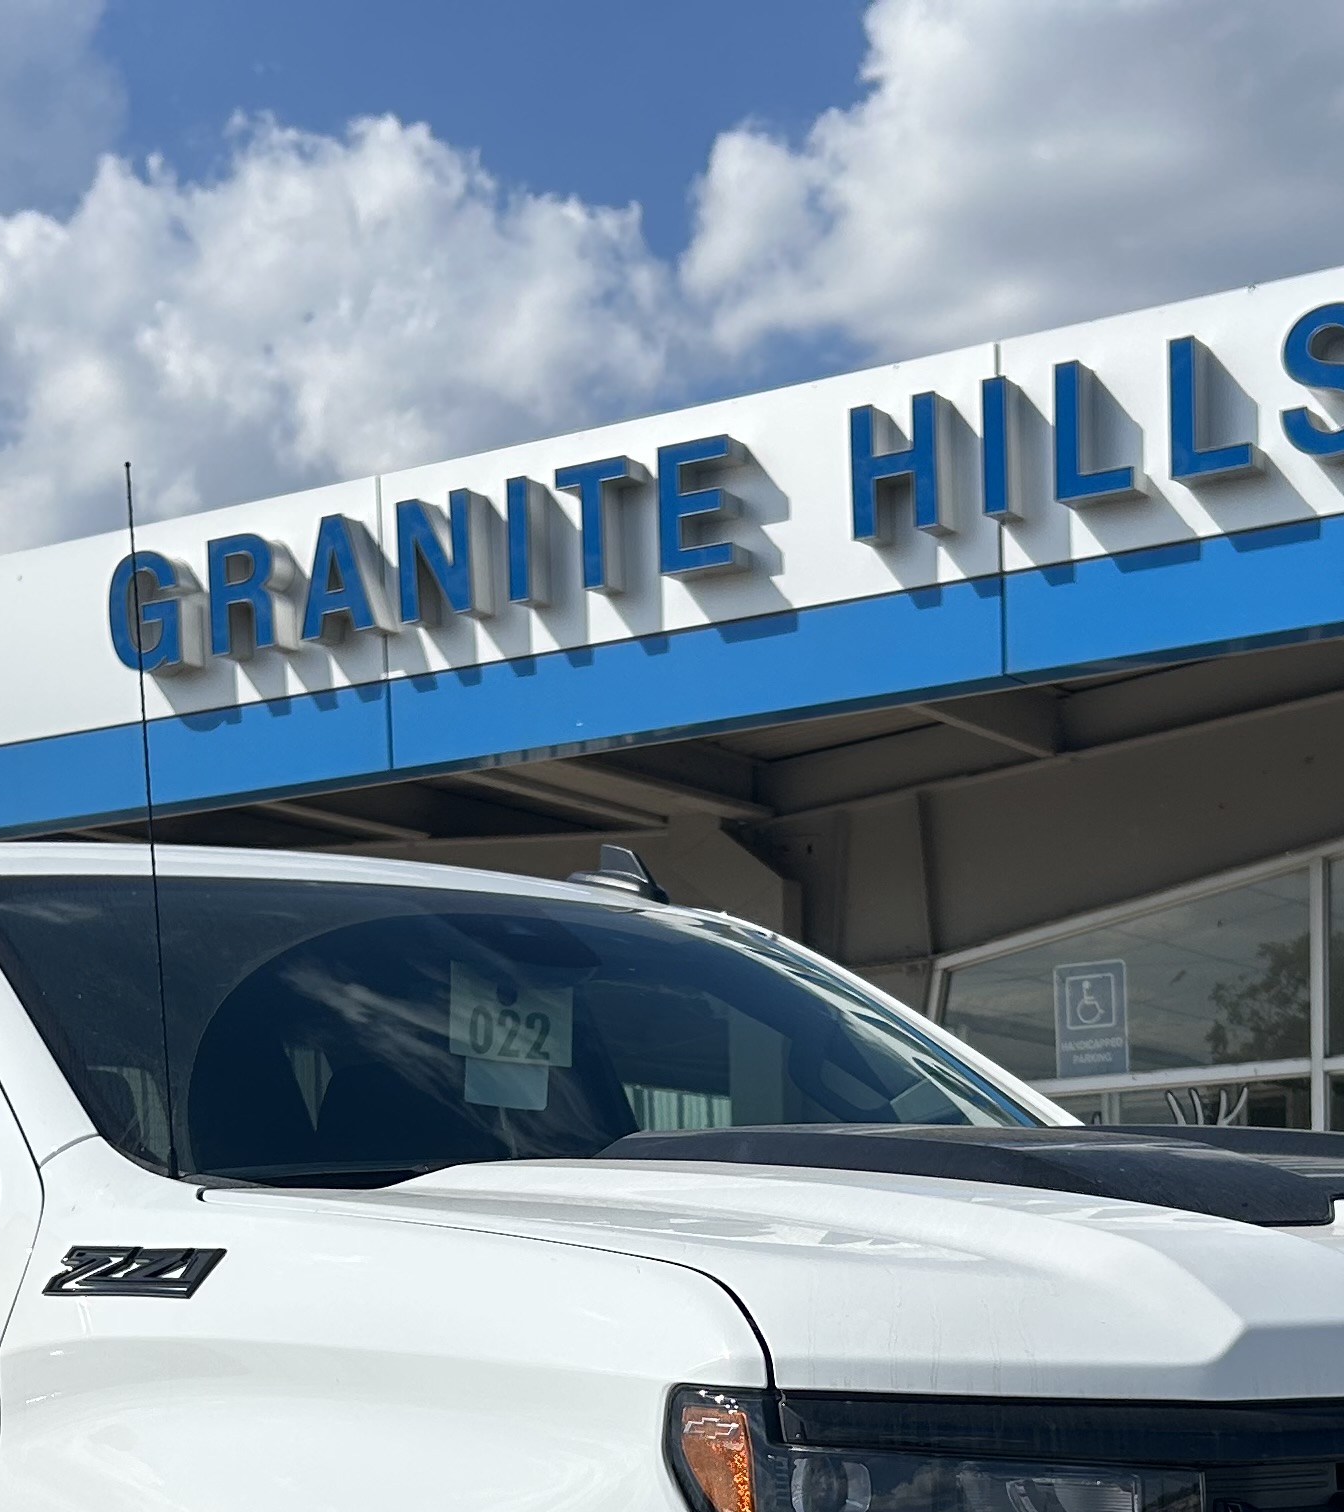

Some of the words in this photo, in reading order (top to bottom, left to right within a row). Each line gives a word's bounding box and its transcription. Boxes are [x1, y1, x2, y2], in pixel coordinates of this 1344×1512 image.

[108, 433, 750, 674] GRANITE
[468, 1004, 551, 1060] 022
[41, 1245, 228, 1299] Z71
